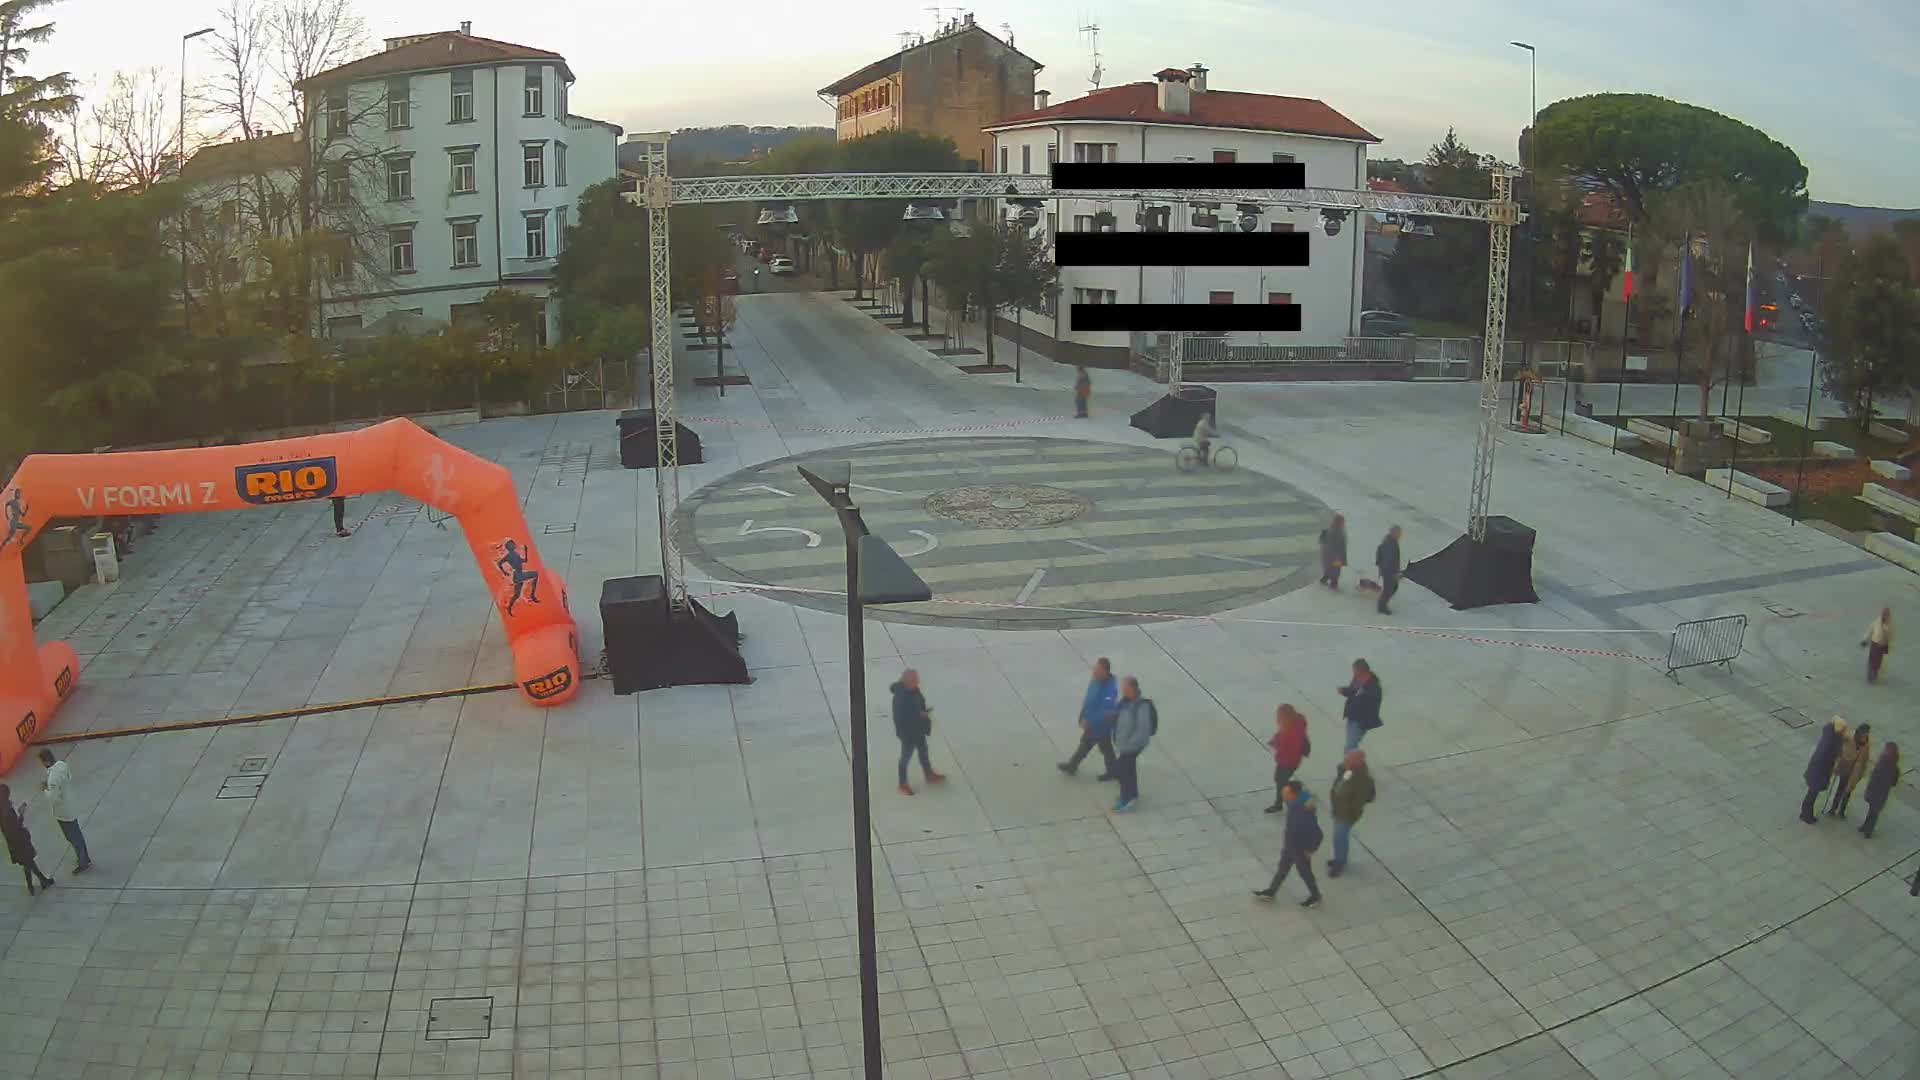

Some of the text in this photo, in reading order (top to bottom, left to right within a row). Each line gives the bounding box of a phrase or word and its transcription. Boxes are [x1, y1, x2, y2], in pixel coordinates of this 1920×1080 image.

[77, 481, 219, 510] V FORMI Z
[245, 466, 327, 496] RIO
[529, 672, 567, 693] RIO
